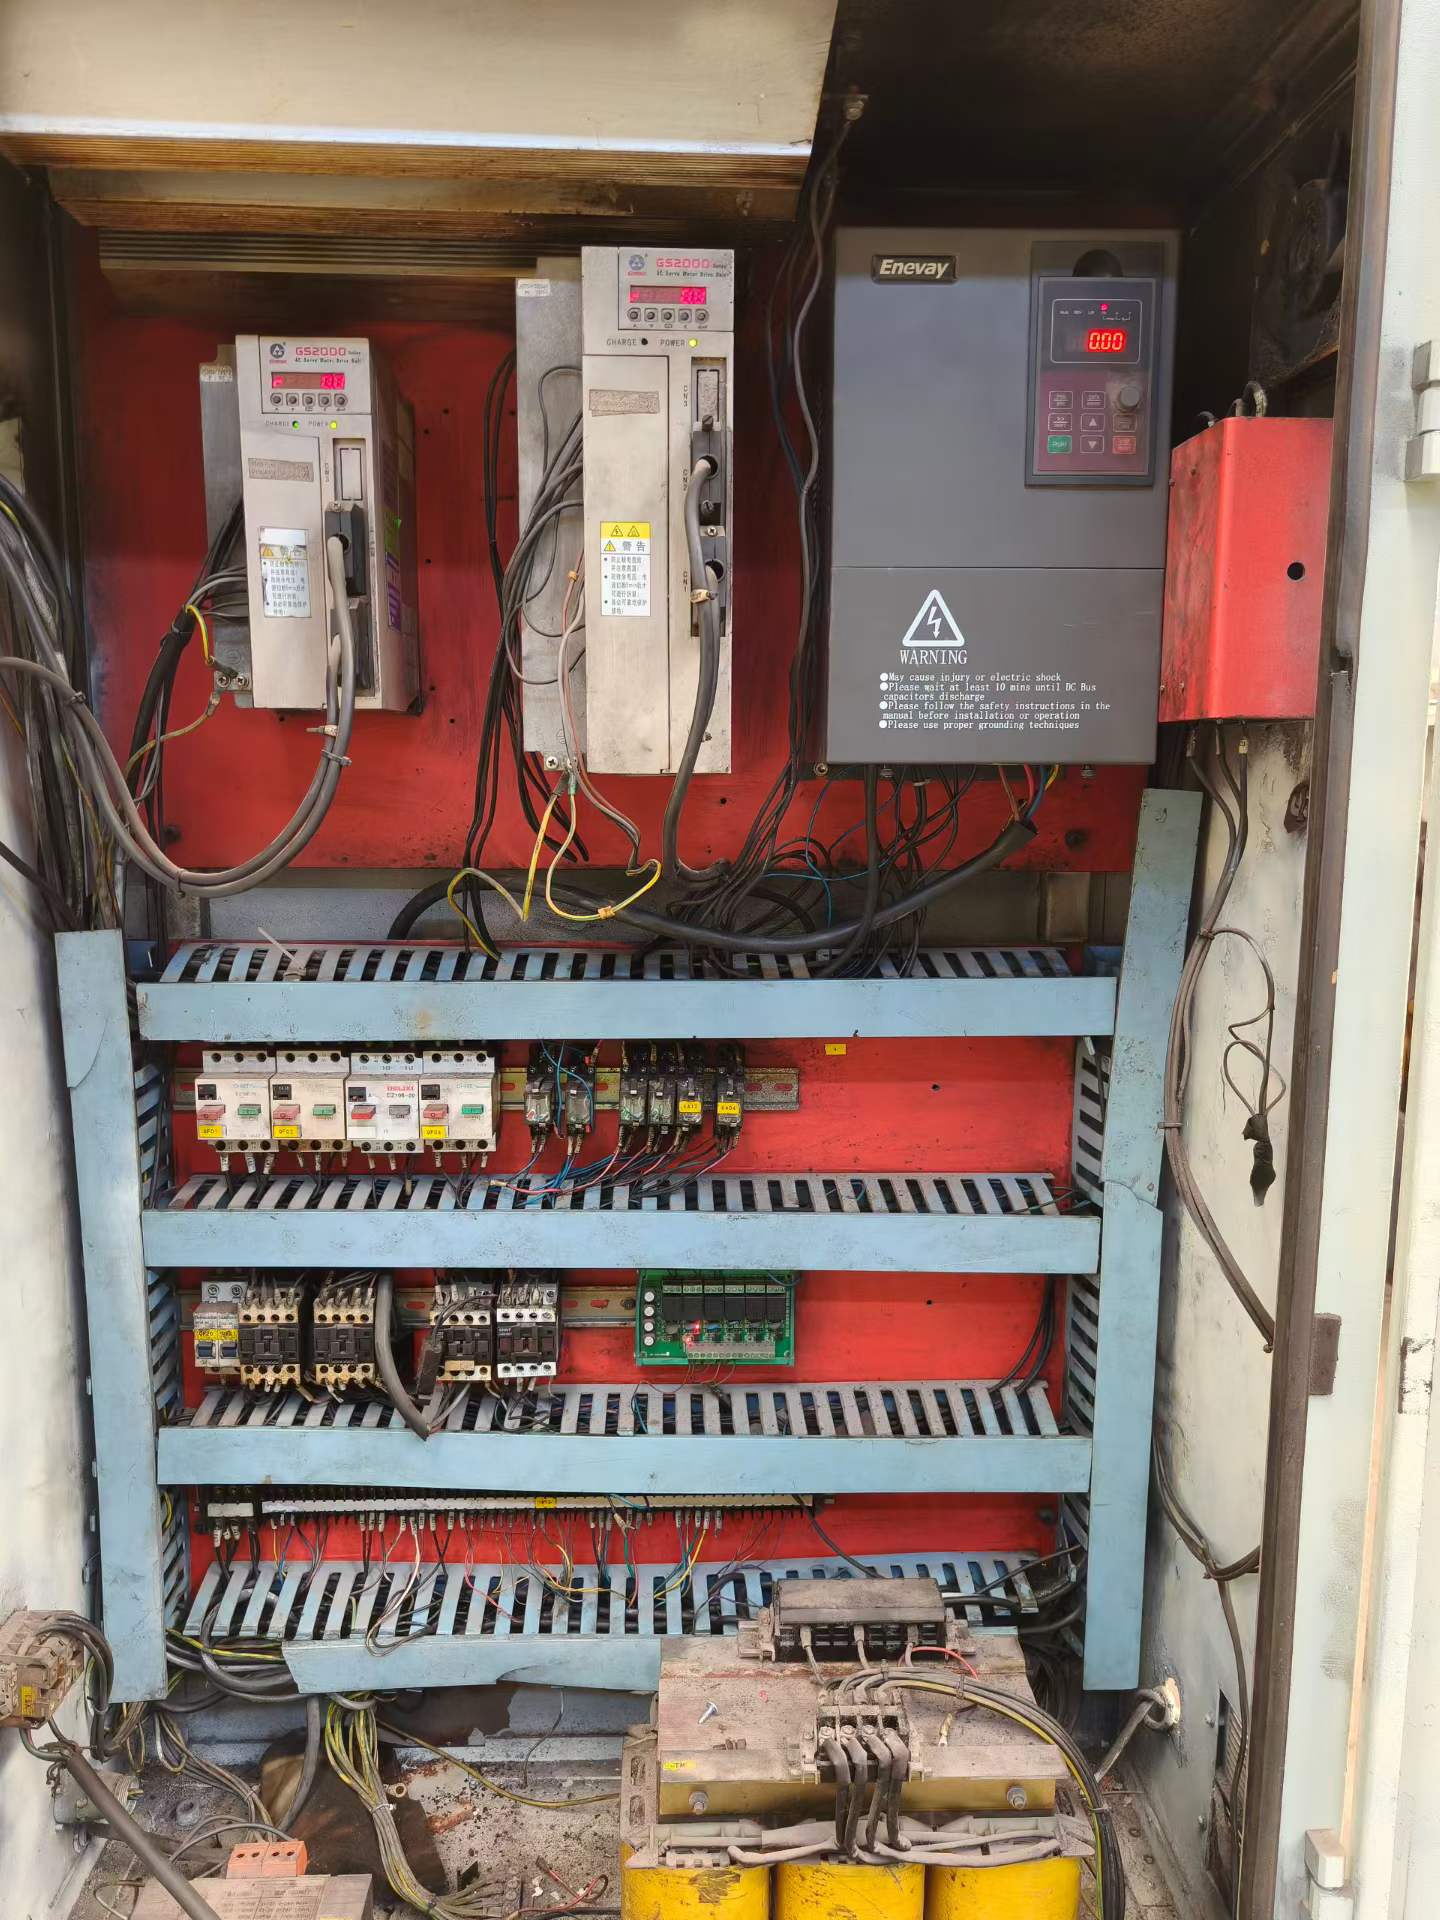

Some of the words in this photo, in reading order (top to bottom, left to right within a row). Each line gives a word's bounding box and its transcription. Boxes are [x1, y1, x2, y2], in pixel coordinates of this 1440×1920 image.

[656, 258, 711, 268] GS2000
[880, 259, 950, 279] Enevay
[1088, 332, 1124, 351] 0.00
[295, 347, 346, 356] GS2000
[900, 649, 968, 665] WARNING
[888, 672, 905, 682] May
[941, 672, 970, 682] injury
[990, 672, 1031, 681] electric
[1035, 672, 1061, 681] shock
[888, 683, 919, 691] Please
[924, 683, 944, 691] wait
[965, 683, 989, 691] least
[996, 683, 1005, 691] 10
[1009, 683, 1031, 691] mins
[1035, 682, 1060, 691] until
[1065, 683, 1076, 691] DC
[1080, 683, 1097, 691] Bus
[883, 692, 934, 701] capacitors
[939, 692, 985, 702] discharge
[888, 701, 919, 710] Please
[924, 701, 955, 710] follow
[960, 701, 975, 710] the
[979, 702, 1010, 711] safety
[1015, 702, 1075, 710] instructions
[1080, 702, 1090, 710] in
[1095, 702, 1111, 710] the
[882, 711, 913, 719] manual
[918, 711, 949, 719] before
[954, 711, 1015, 720] installation
[1034, 712, 1080, 721] operation
[887, 720, 919, 729] Please
[923, 721, 939, 729] use
[943, 722, 974, 730] proper
[978, 720, 1024, 730] grounding
[1029, 721, 1080, 730] techniques
